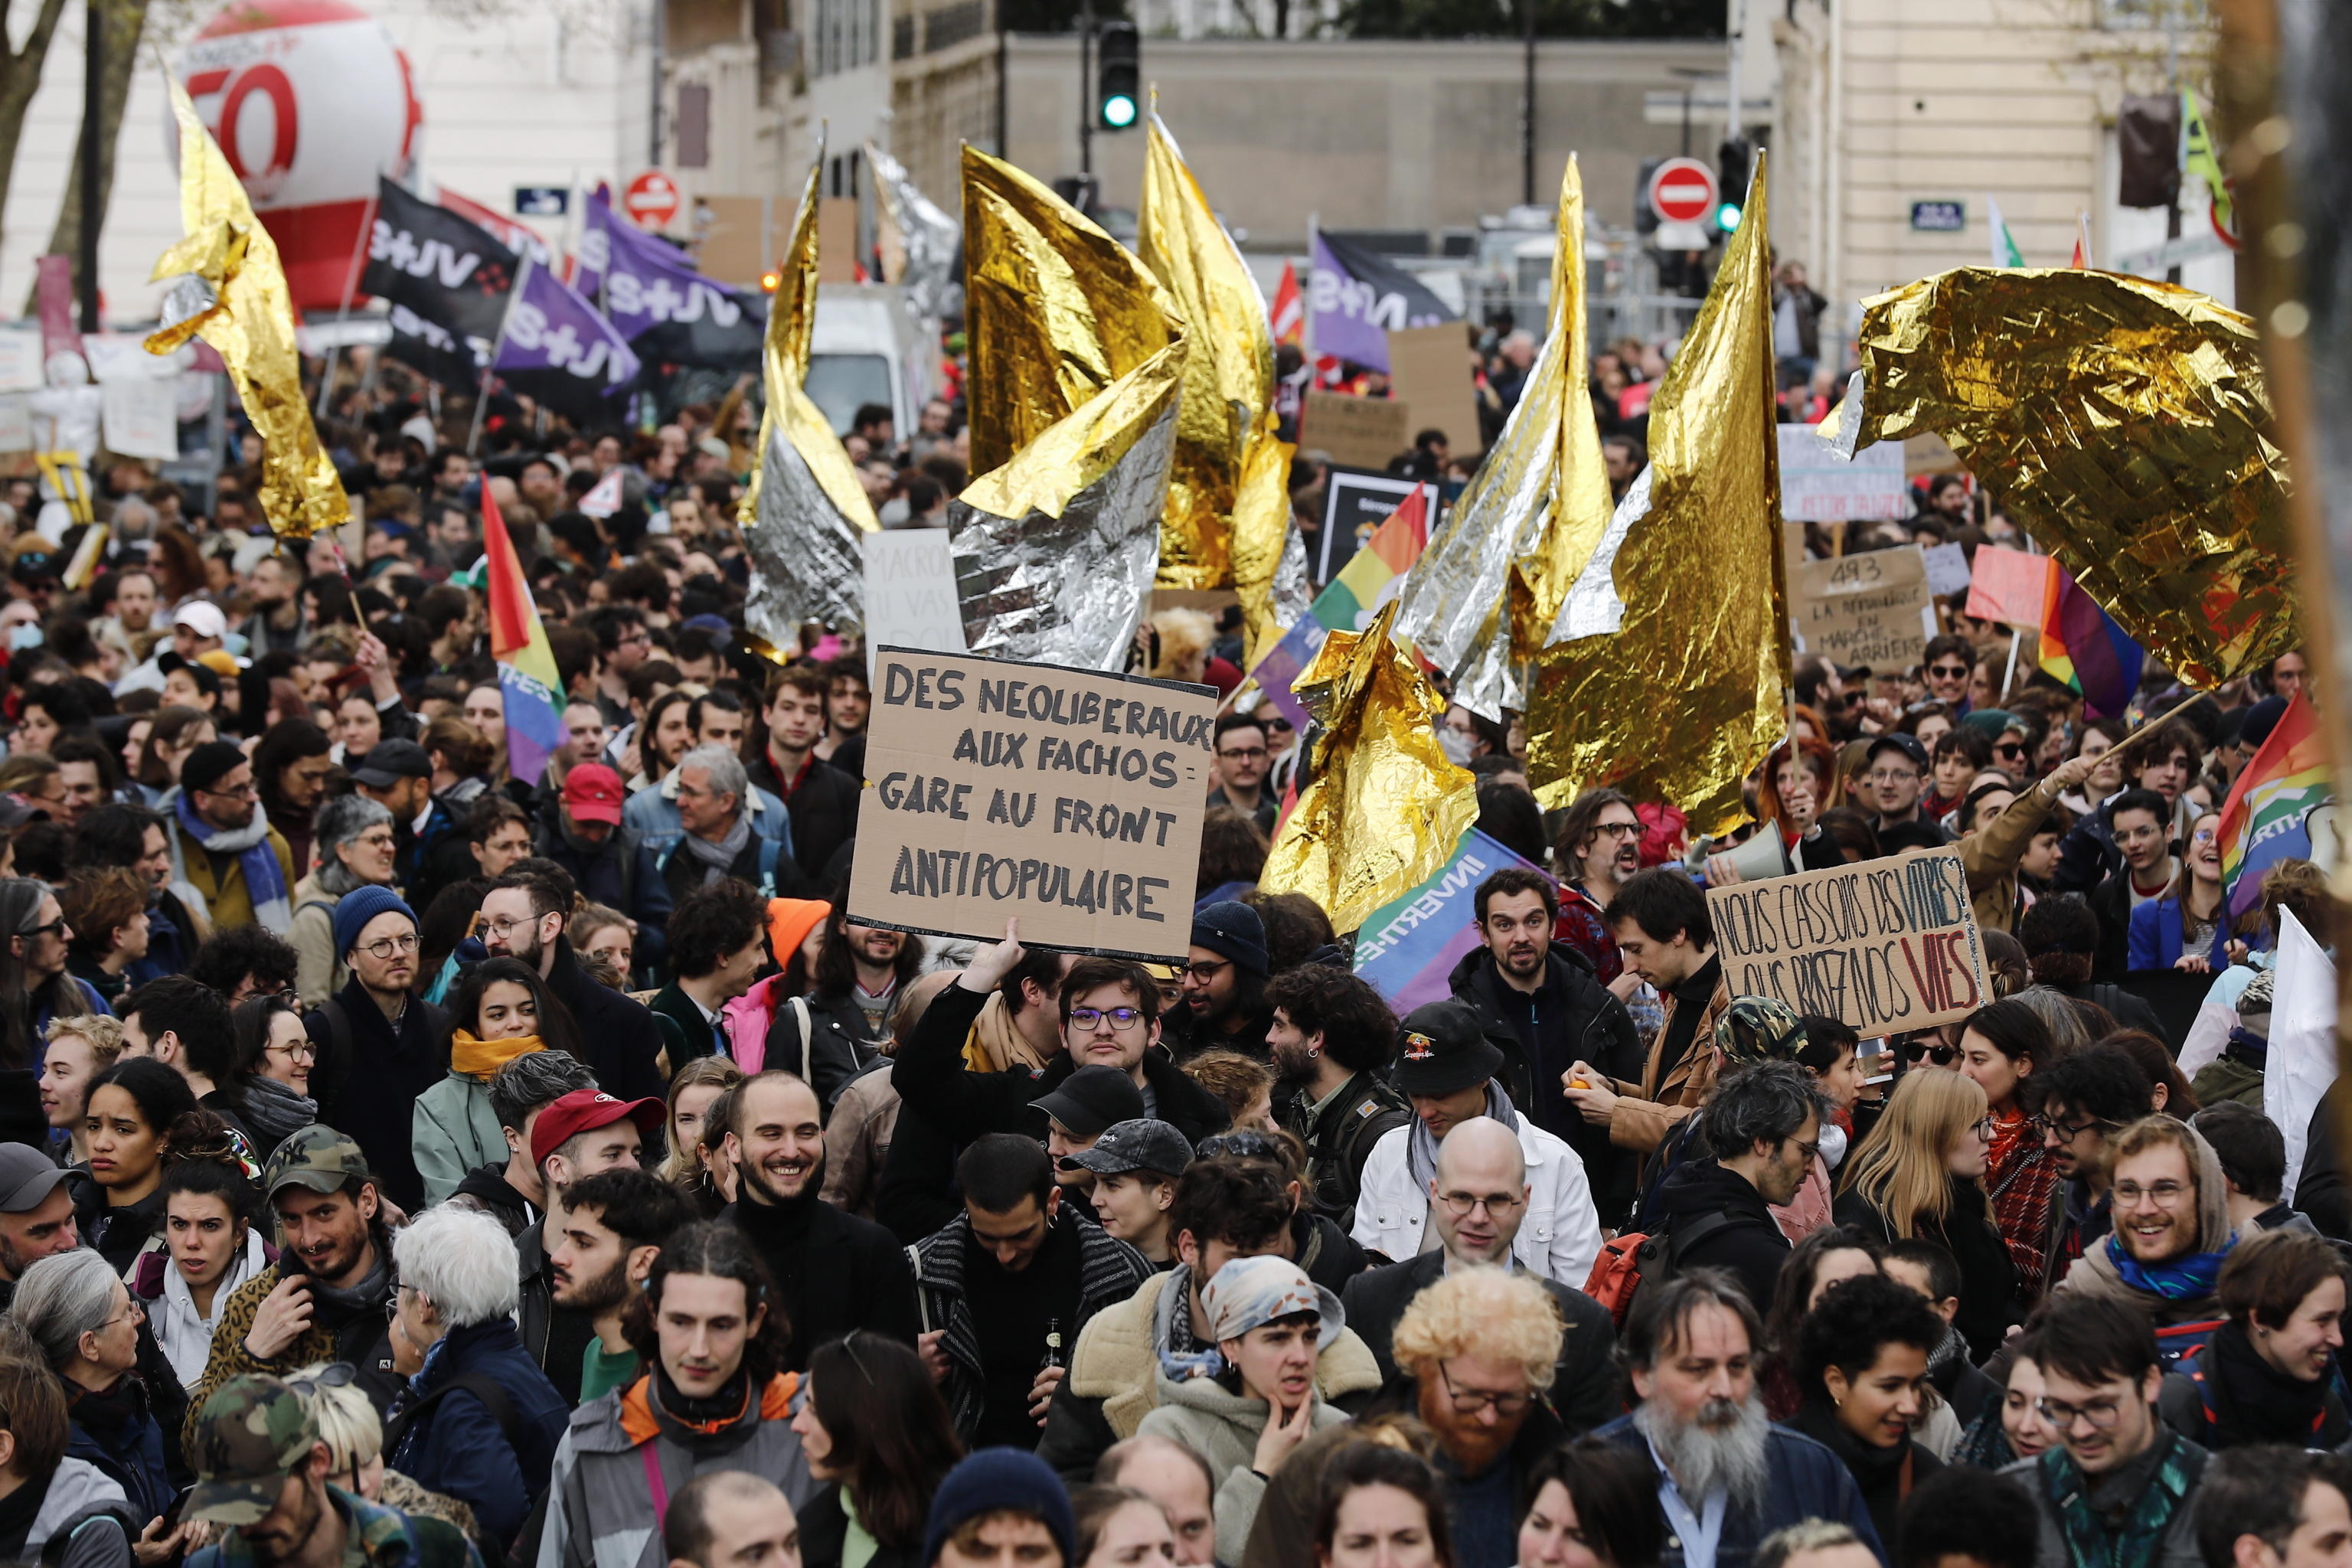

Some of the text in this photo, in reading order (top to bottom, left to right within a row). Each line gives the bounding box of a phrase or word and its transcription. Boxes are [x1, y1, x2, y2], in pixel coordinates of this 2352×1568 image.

[1813, 603, 1834, 621] LA
[884, 663, 1214, 752] DES NEOLIBERAUX
[952, 727, 1028, 769] AUX
[1037, 736, 1178, 789] FACHOS
[879, 772, 1177, 848] GARE AU FRONT
[890, 844, 1170, 923] ANTIPOPULAIRE
[1712, 887, 1779, 960] NOUS
[1779, 873, 1869, 950] CASSONS
[1867, 868, 1906, 936] DES
[1849, 940, 1911, 1029] NOS
